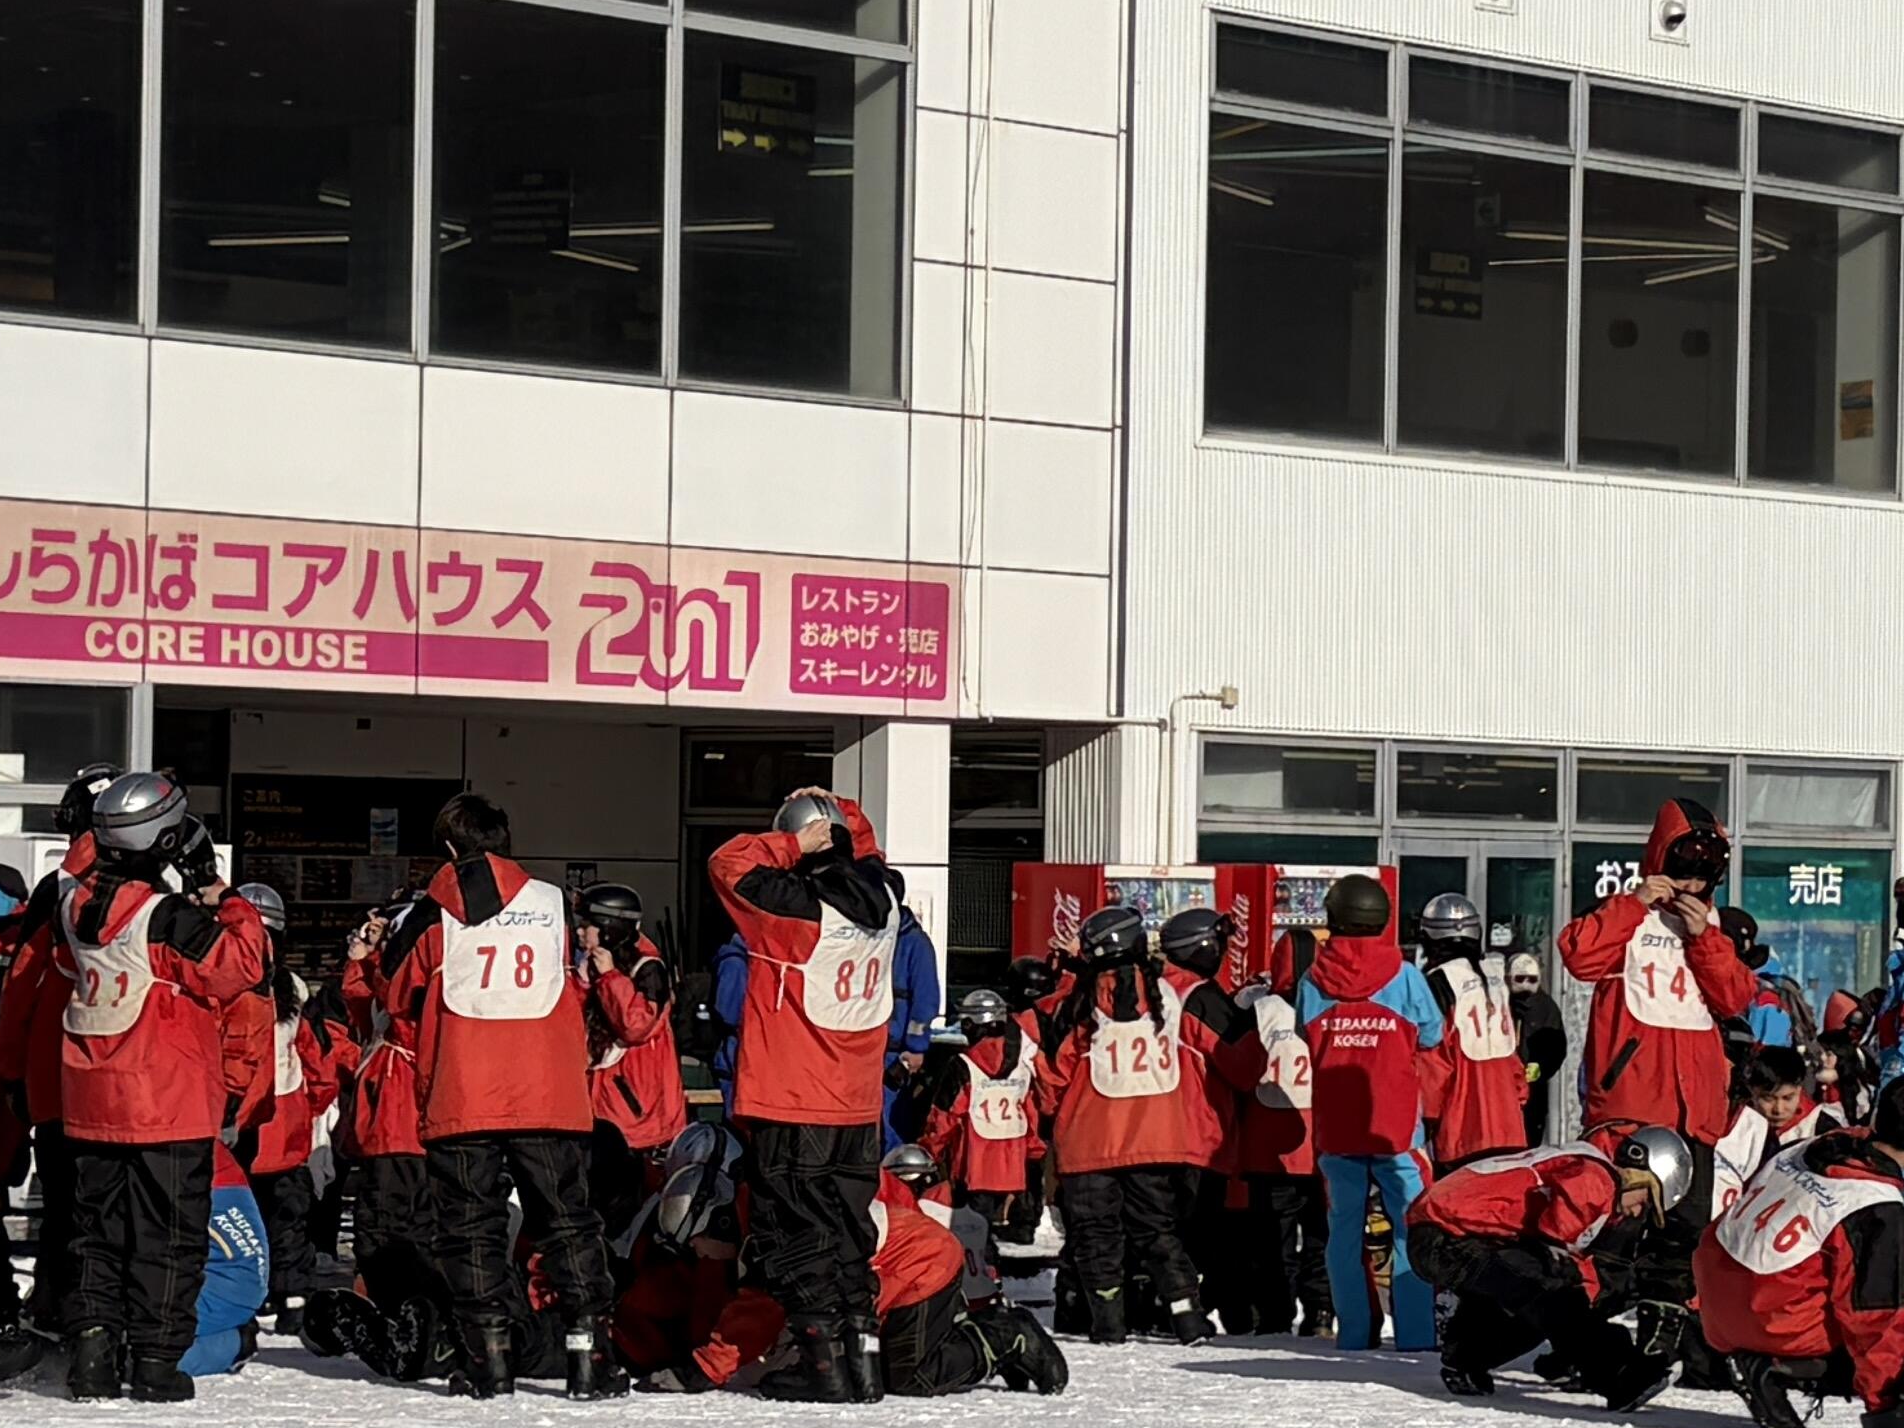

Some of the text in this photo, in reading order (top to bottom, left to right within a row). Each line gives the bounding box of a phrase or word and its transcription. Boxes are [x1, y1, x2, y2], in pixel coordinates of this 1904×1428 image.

[799, 585, 901, 616] レストラン
[84, 620, 368, 671] CORE HOUSE
[799, 658, 938, 690] スキーレンタル
[476, 943, 535, 989] 78
[833, 958, 881, 1003] 80
[1105, 1034, 1172, 1075] 123
[1732, 1185, 1810, 1254] 146
